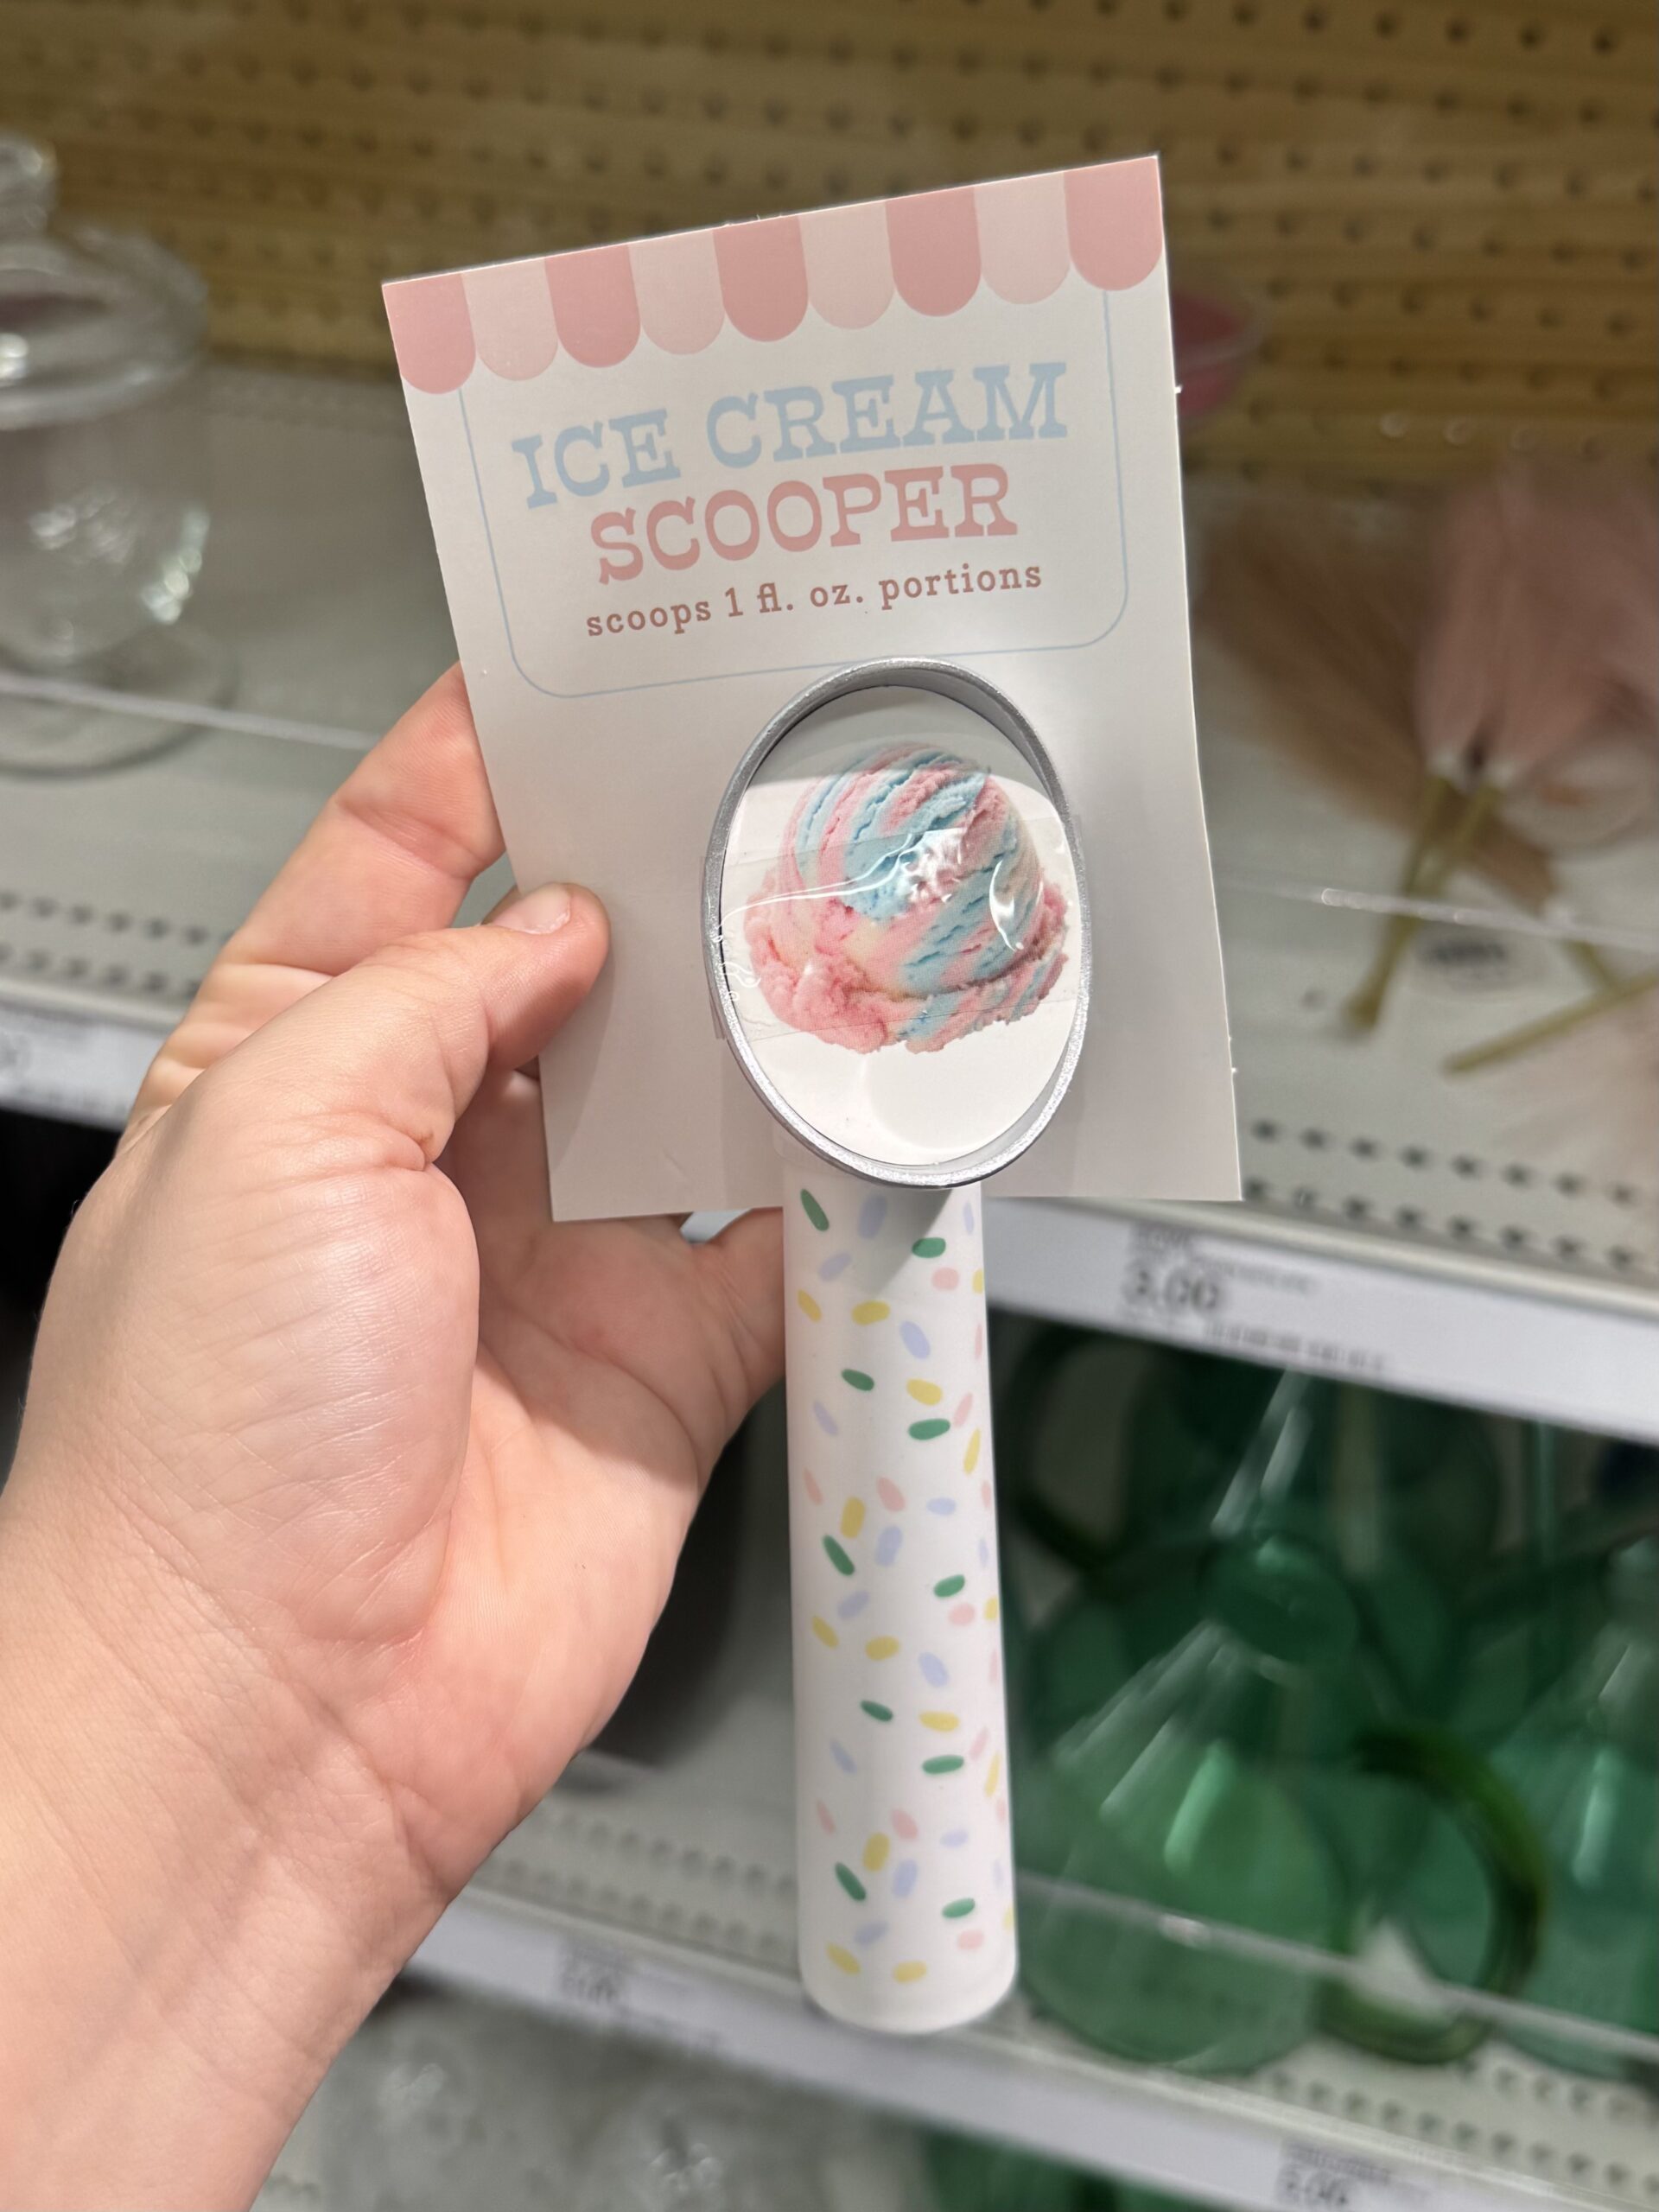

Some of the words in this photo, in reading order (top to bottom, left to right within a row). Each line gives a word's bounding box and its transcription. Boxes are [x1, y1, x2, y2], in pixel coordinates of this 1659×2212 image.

[512, 408, 681, 509] ICE
[707, 362, 1067, 468] CREAM
[590, 463, 1018, 585] SCOOPER
[587, 601, 711, 637] scoops
[725, 588, 743, 618] 1
[756, 582, 793, 613] fl.
[810, 586, 862, 607] oz.
[879, 564, 1041, 610] portions
